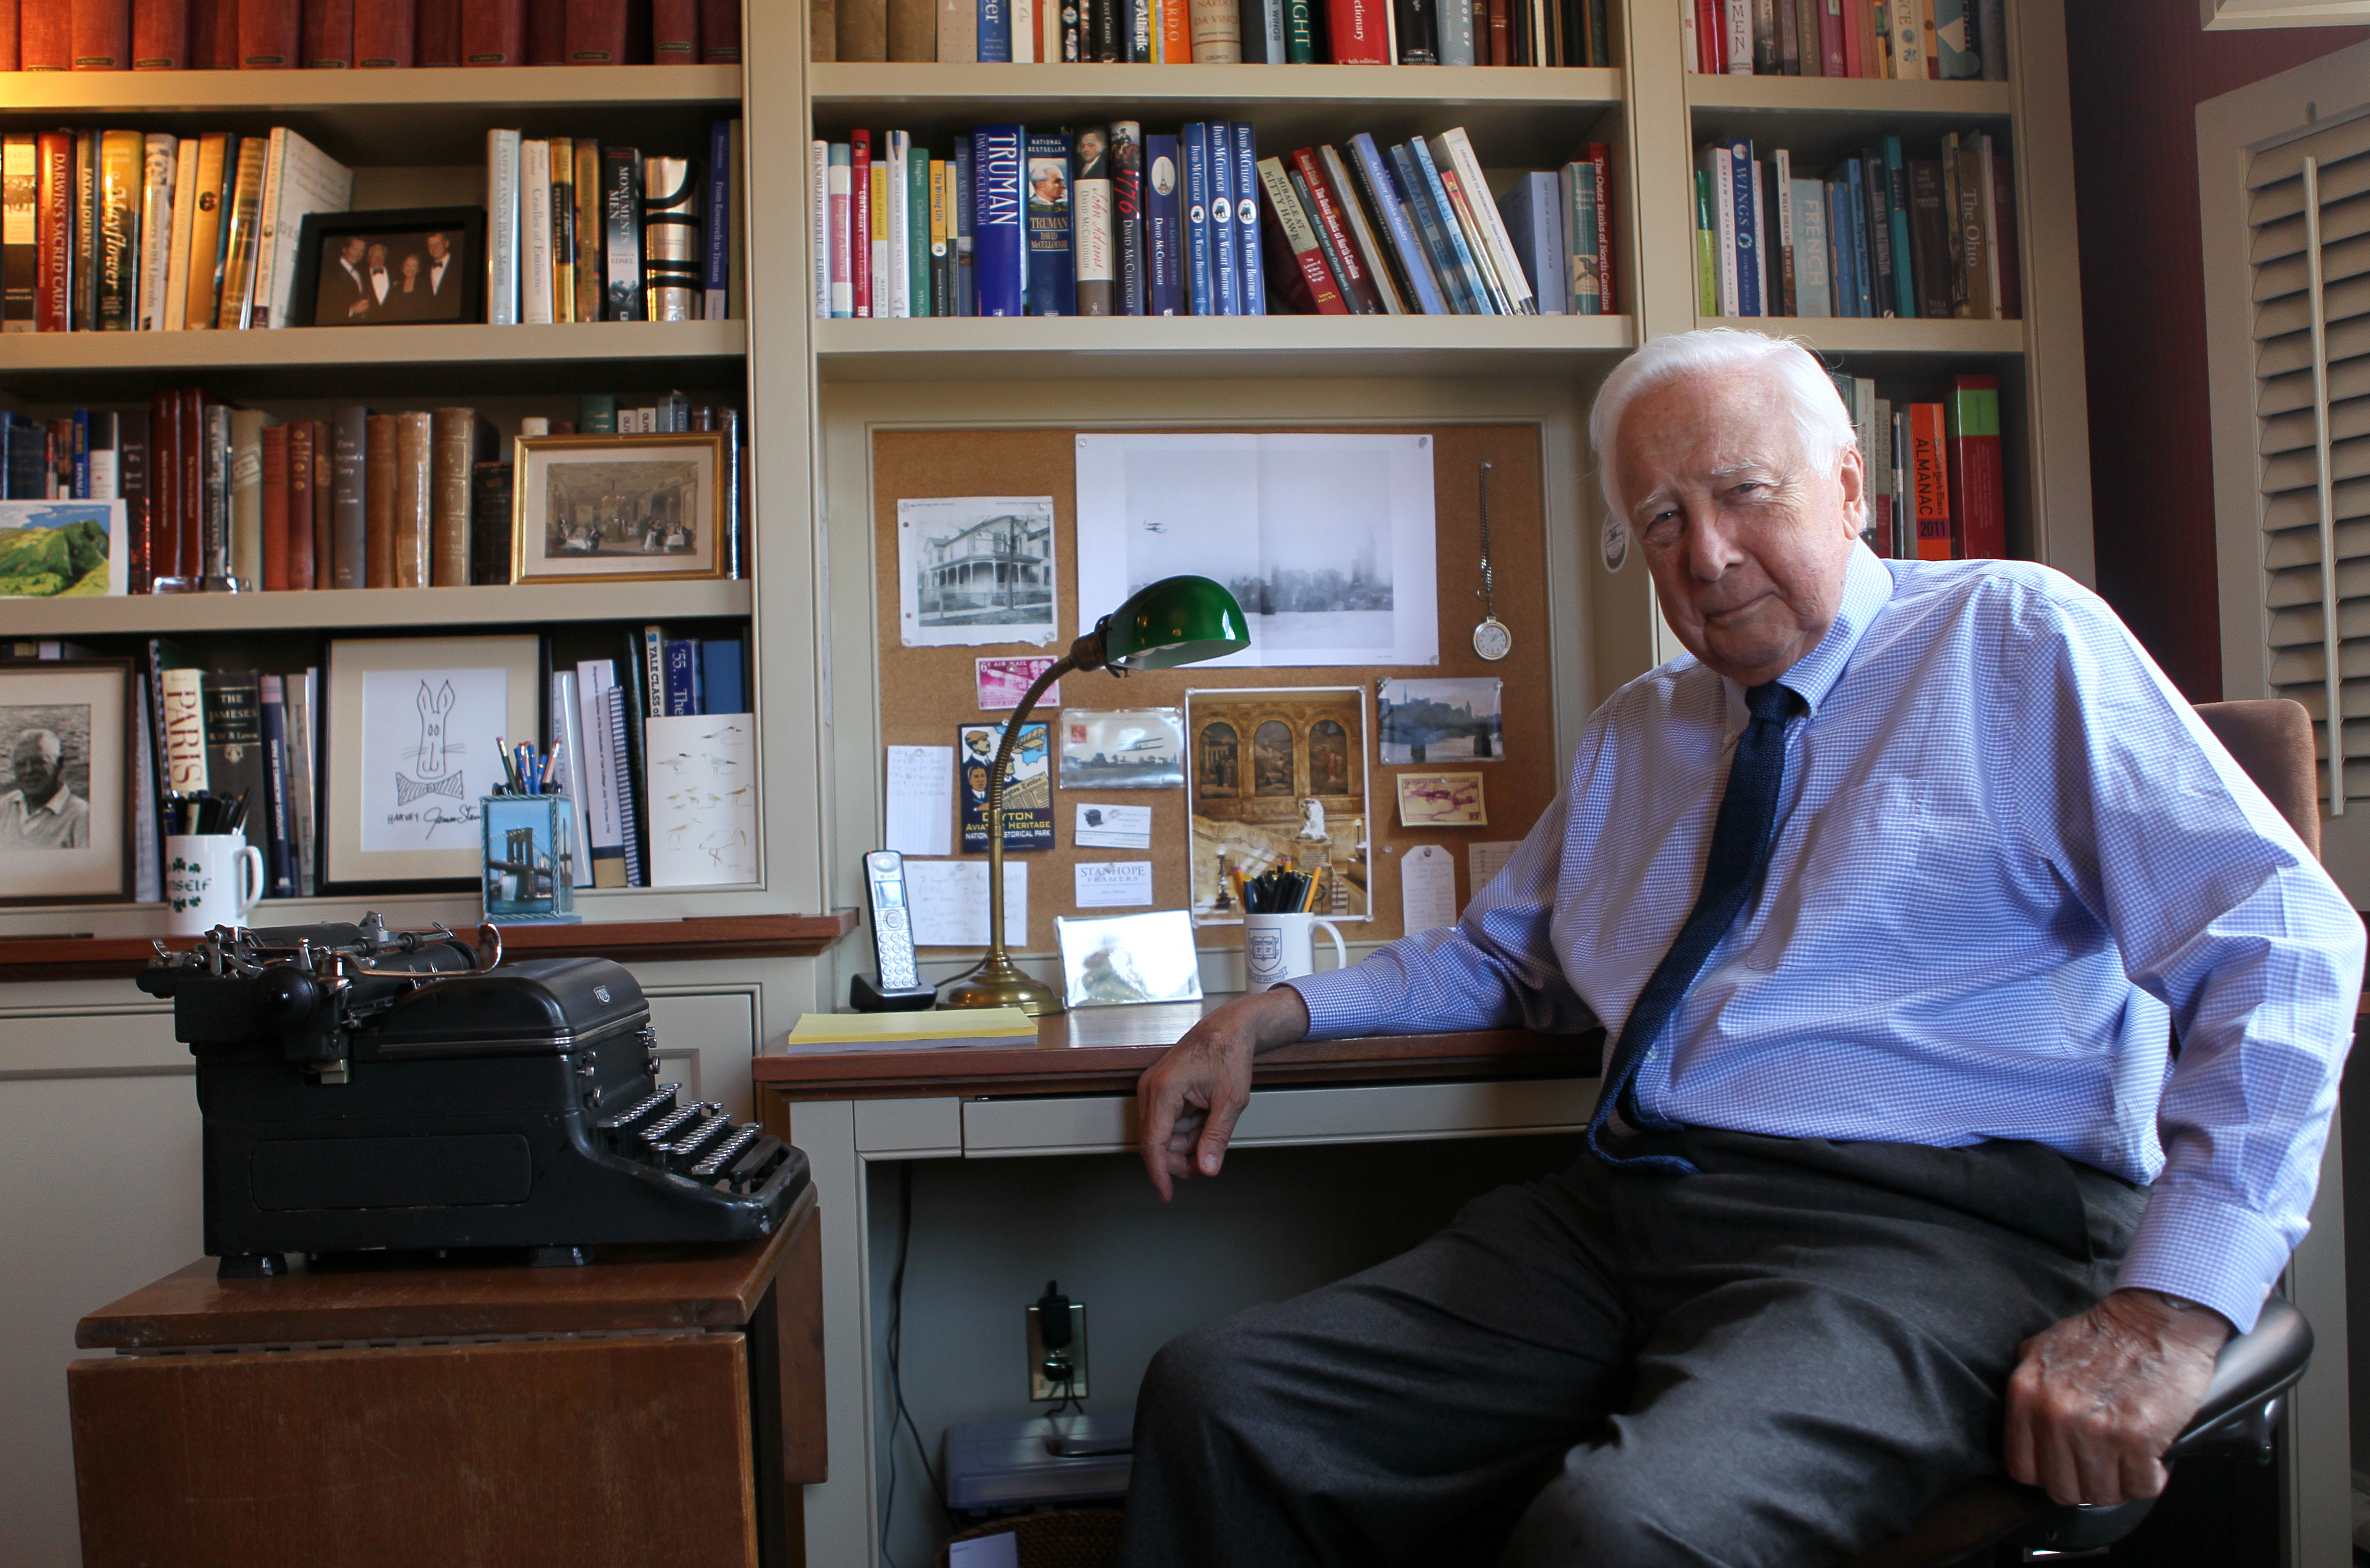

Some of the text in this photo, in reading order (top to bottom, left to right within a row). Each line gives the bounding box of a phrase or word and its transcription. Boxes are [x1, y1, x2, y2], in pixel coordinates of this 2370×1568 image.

[1134, 7, 1149, 51] Atlantic
[1273, 9, 1281, 41] WINGS
[914, 160, 924, 185] Hughes
[976, 133, 987, 226] DAVID McCULLOUGH
[988, 133, 1018, 225] TRUMAN
[1300, 155, 1312, 170] David
[83, 168, 93, 204] FATAL
[715, 182, 724, 202] From
[814, 147, 824, 246] THE KNOWLEDGE DEFICIT
[934, 186, 942, 208] Writing
[958, 154, 968, 230] DAVID McCULLOUGH
[1092, 188, 1109, 217] John
[1114, 169, 1140, 219] 1776
[1277, 176, 1305, 229] MIRACLE AT
[1314, 188, 1325, 198] The
[1370, 161, 1407, 241] An Outer Banks Reader
[1399, 163, 1418, 189] Aloft
[1411, 191, 1422, 203] At
[1418, 207, 1434, 229] Last
[1420, 155, 1439, 181] Aloft
[1433, 184, 1445, 196] At
[1439, 200, 1454, 221] Last
[1460, 149, 1477, 182] LOCOMOTIVE
[1477, 190, 1492, 221] AEROMOTIVE
[1737, 167, 1749, 226] WINGS
[608, 191, 619, 219] MEN
[619, 166, 630, 243] MONUMENTS
[714, 204, 723, 239] Roosevelt
[835, 199, 848, 230] Images
[916, 199, 925, 229] Culture
[1191, 145, 1205, 287] DAVID McCULLOUGH THE WRIGHT BROTHERS
[1213, 125, 1231, 298] DAVID McCULLOUGH THE WRIGHT BROTHERS
[1238, 127, 1257, 300] DAVID McCULLOUGH THE WRIGHT BROTHERS
[1264, 171, 1300, 242] KITTY HAWK
[1318, 198, 1332, 215] Outer
[52, 153, 66, 317] DARWIN'S SACRED CAUSE
[81, 205, 92, 259] JOURNEY
[102, 186, 128, 290] Mayflower
[1030, 217, 1068, 229] TRUMAN
[1081, 190, 1091, 269] DAVID McCULLOUGH
[1326, 215, 1338, 232] Banks
[1595, 157, 1611, 310] The Outer Banks of North Carolina
[1963, 189, 1981, 267] The Ohio
[149, 242, 160, 264] with
[532, 189, 545, 295] Cradles of Eminence
[839, 242, 848, 277] America
[916, 239, 925, 276] Complaint
[1031, 240, 1068, 248] McCULLOUGH
[1154, 217, 1166, 285] DAVID McCULLOUGH
[1316, 223, 1329, 239] Toide
[1326, 248, 1335, 257] the
[1331, 257, 1342, 273] Outer
[1337, 274, 1350, 291] Banks
[1336, 239, 1350, 256] North
[1804, 200, 1823, 286] FRENCH
[712, 252, 721, 280] Truman
[857, 260, 865, 291] Leadership
[1123, 220, 1135, 308] DAVID McCULLOUGH
[1344, 256, 1358, 279] Carolina
[147, 268, 159, 307] Lincoln
[1915, 438, 1933, 515] ALMANAC
[1935, 453, 1944, 470] New
[1933, 472, 1944, 490] York
[1937, 491, 1945, 515] Times
[1920, 521, 1946, 536] 2011
[649, 646, 660, 706] YALE CLASS
[208, 709, 257, 722] JAMESES
[220, 694, 243, 703] THE
[674, 688, 688, 715] The
[167, 690, 202, 784] PARIS
[387, 813, 418, 824] HARVEY
[1008, 821, 1050, 829] HERITAGE
[1081, 866, 1146, 877] STANHOPE
[1263, 973, 1283, 981] VERITAS
